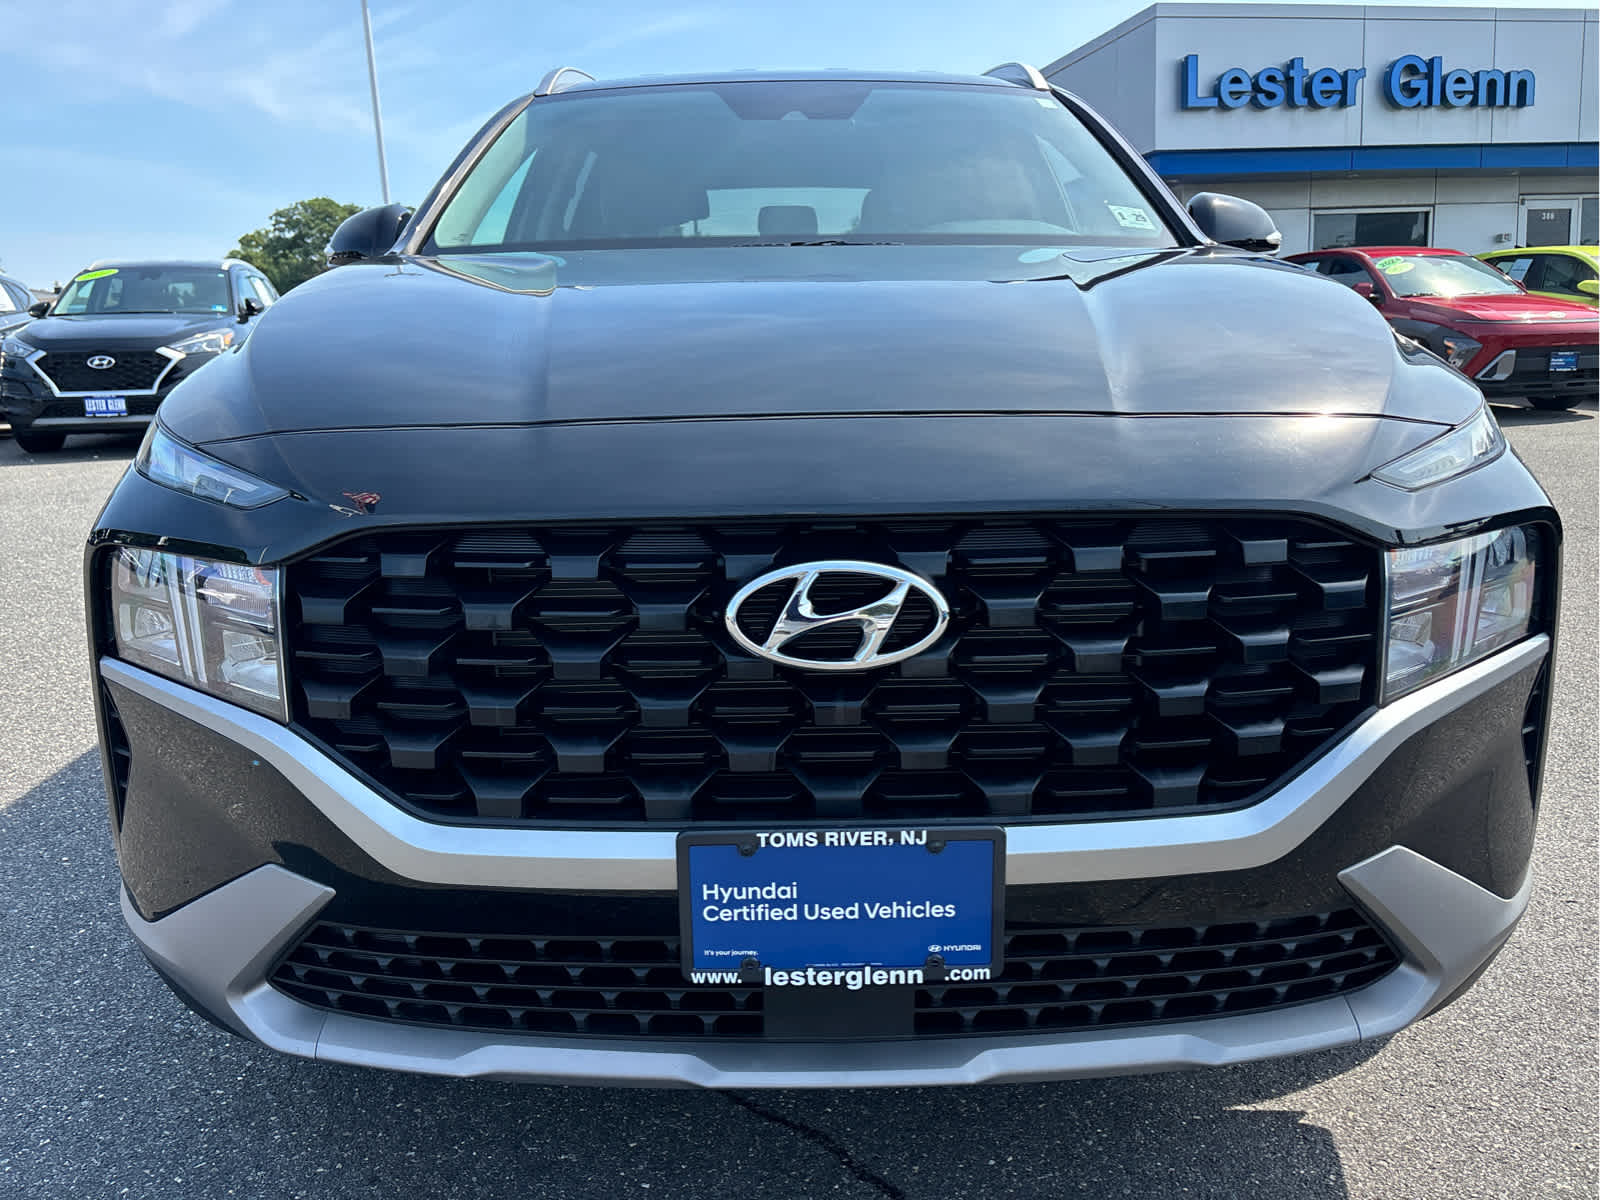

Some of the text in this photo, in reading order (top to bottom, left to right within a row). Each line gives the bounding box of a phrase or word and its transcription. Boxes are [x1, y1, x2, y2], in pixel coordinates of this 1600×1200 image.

[1181, 54, 1535, 109] Lester Glenn
[756, 830, 927, 848] TOMS RIVER, NJ
[702, 881, 798, 904] Hyundai
[702, 900, 956, 922] Certified Used Vehicles
[943, 944, 982, 952] HYUNDAI
[690, 966, 991, 990] www. lesterglenn .com
